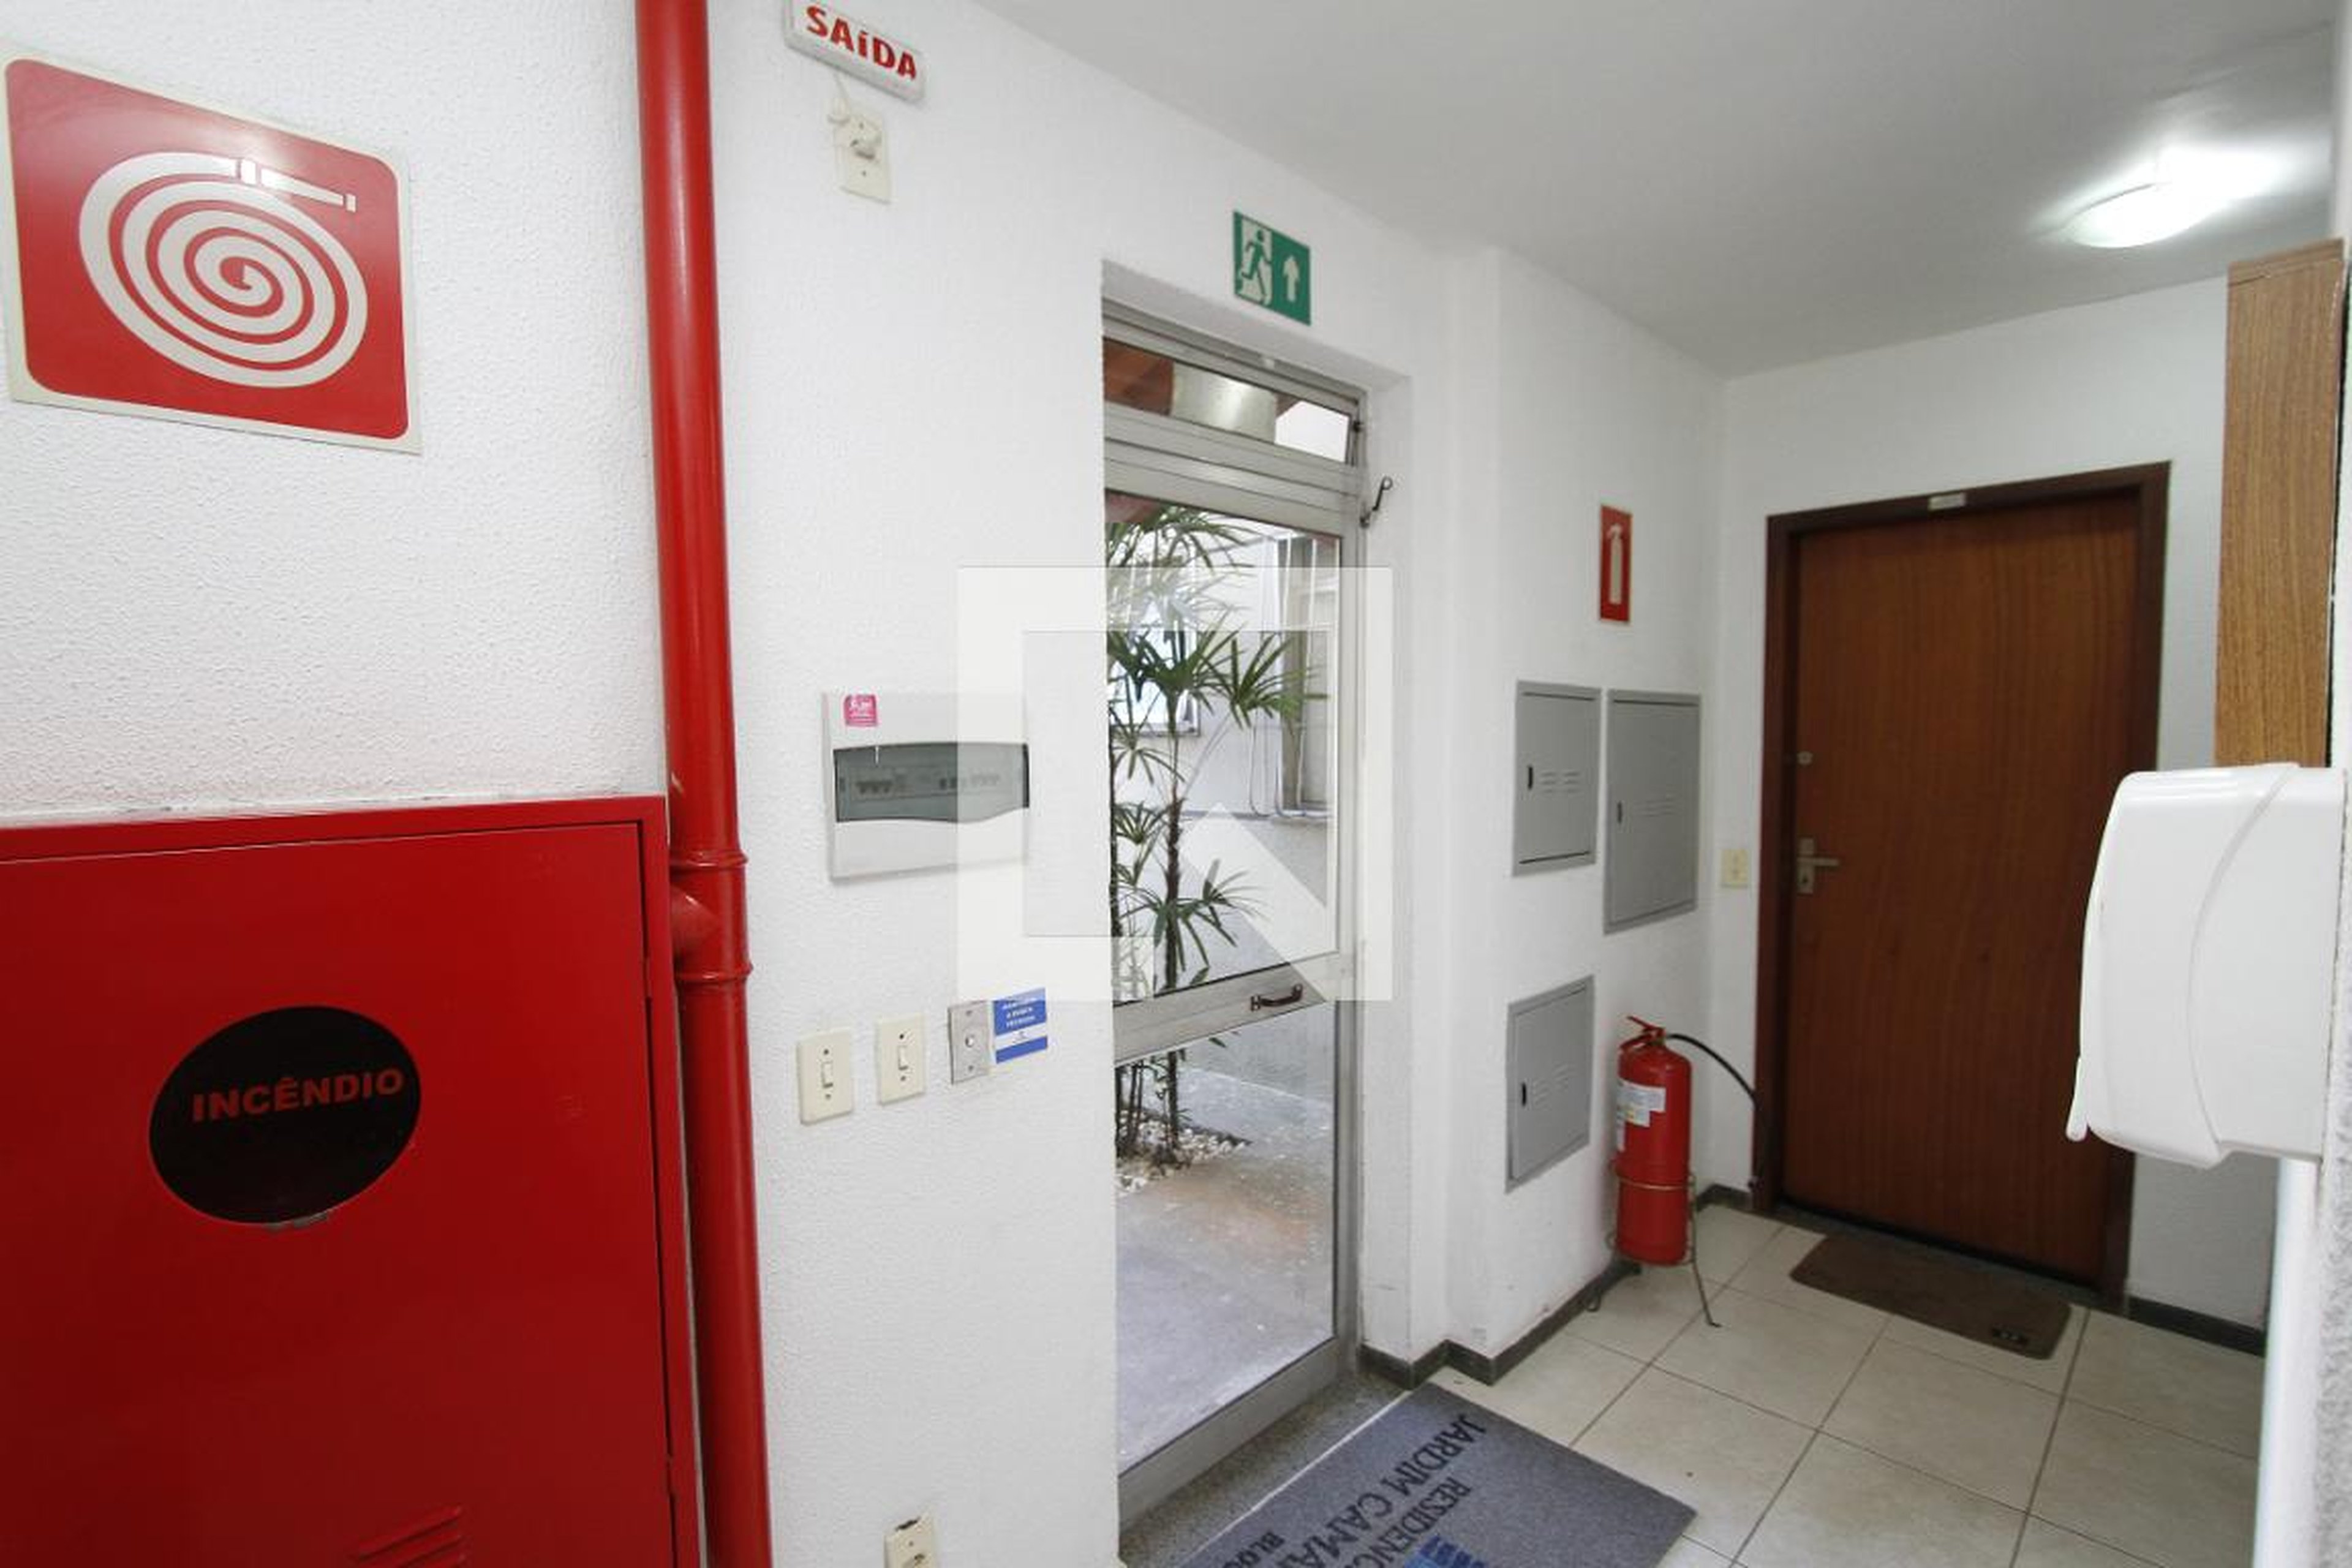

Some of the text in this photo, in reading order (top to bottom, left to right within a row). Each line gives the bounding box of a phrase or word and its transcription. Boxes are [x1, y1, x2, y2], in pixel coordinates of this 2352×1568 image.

[192, 1068, 405, 1123] INCÊNDIO
[1276, 1413, 1487, 1568] JARDIM CAMA
[1345, 1477, 1472, 1568] RESIDENC
